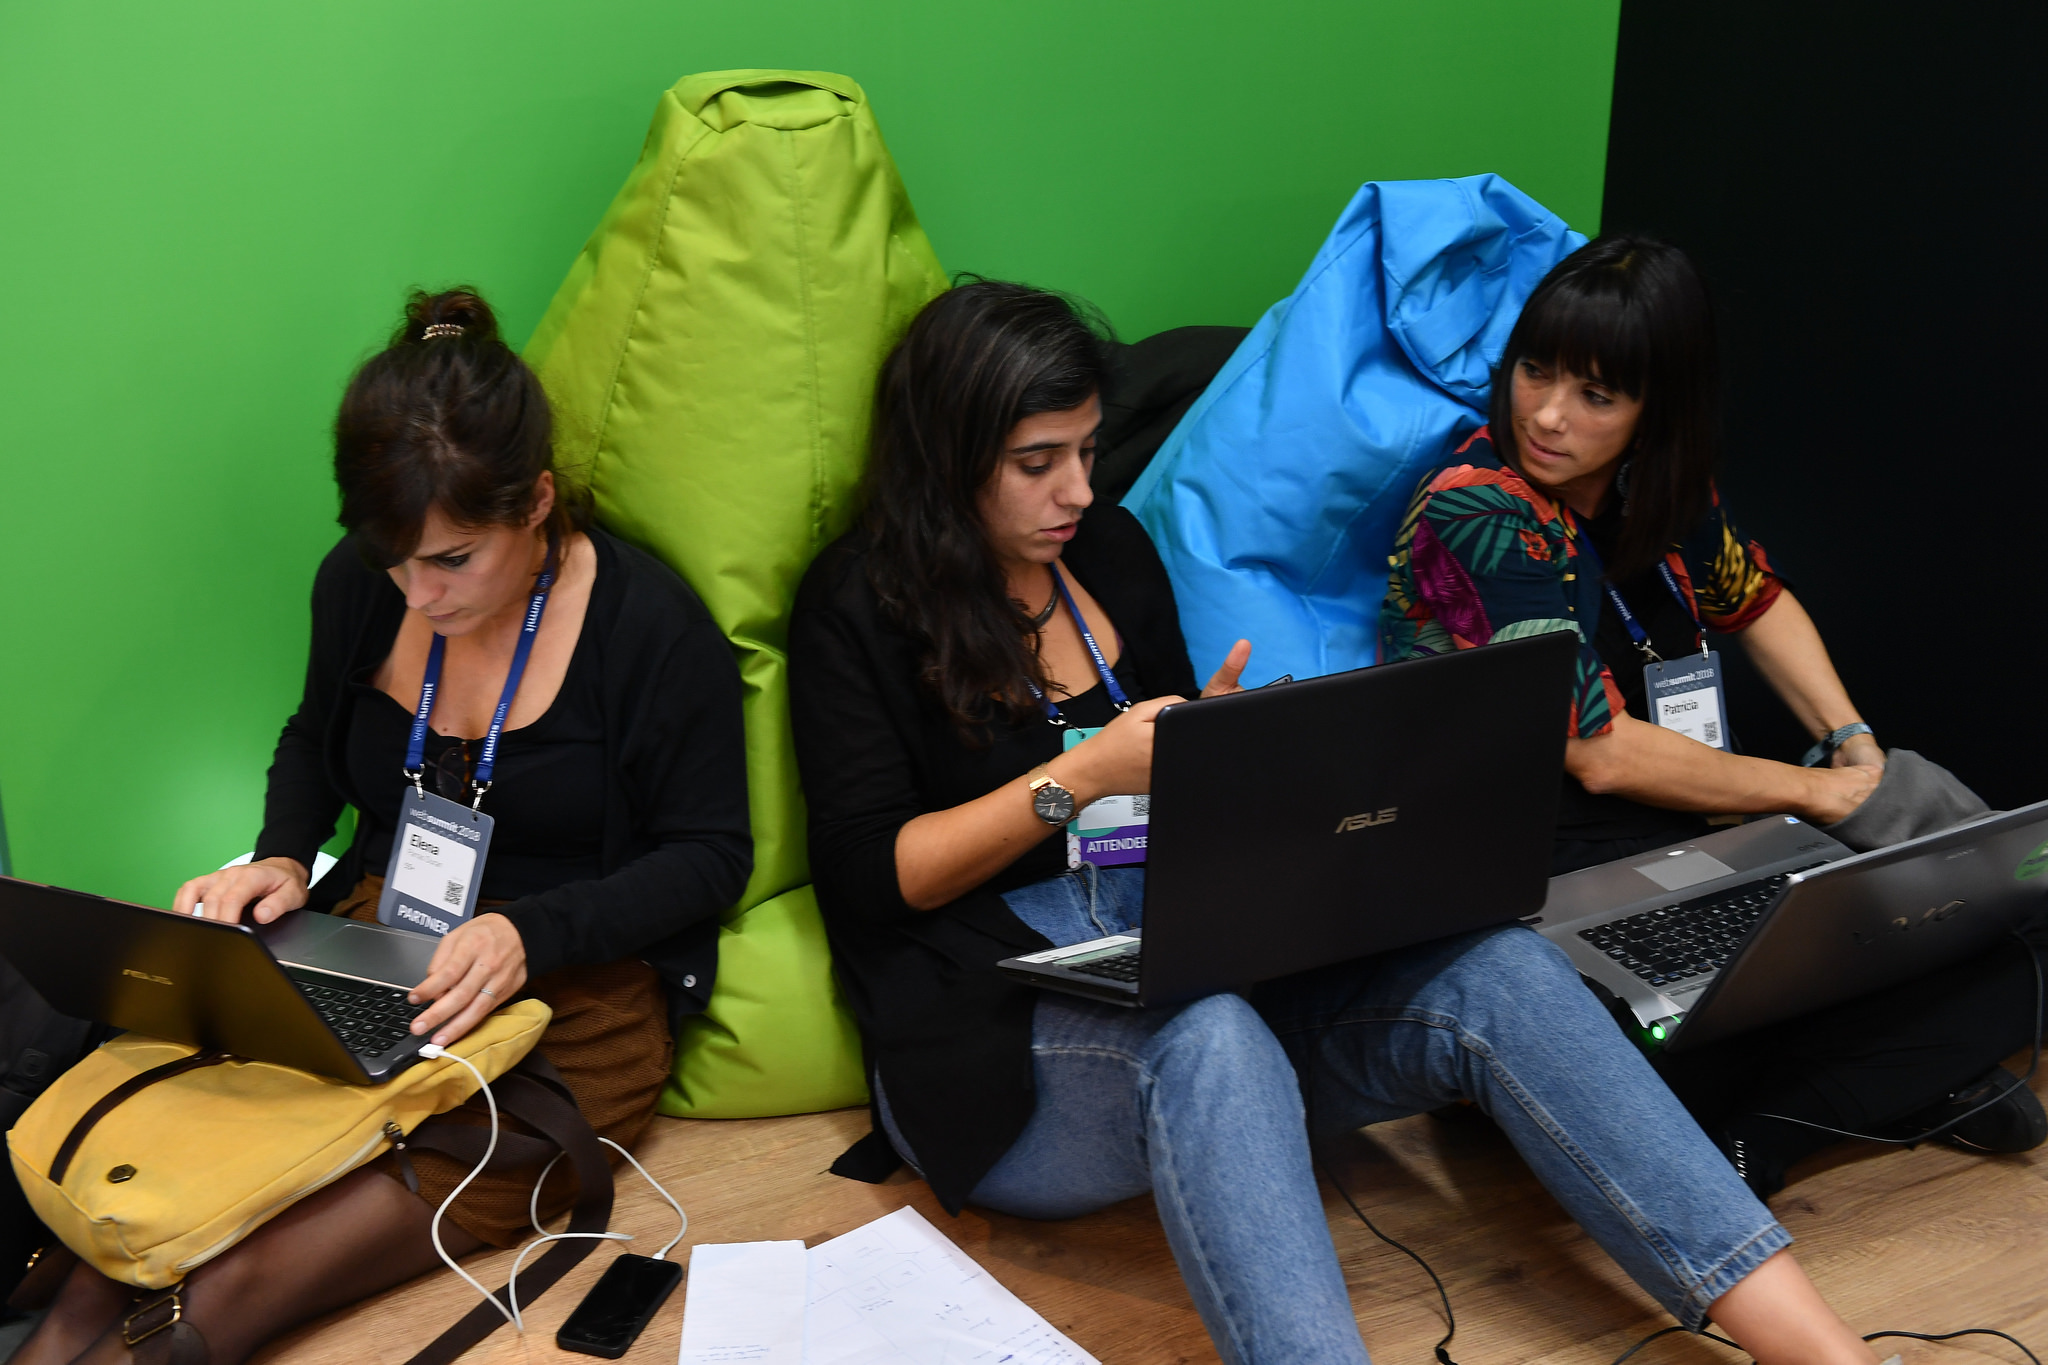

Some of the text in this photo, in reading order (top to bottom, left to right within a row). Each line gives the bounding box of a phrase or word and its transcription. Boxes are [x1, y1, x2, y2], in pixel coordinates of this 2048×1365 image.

[1335, 806, 1398, 833] ASUS
[410, 834, 440, 855] Elena
[1086, 836, 1148, 853] ATTENDEE
[397, 904, 450, 935] PARTNER
